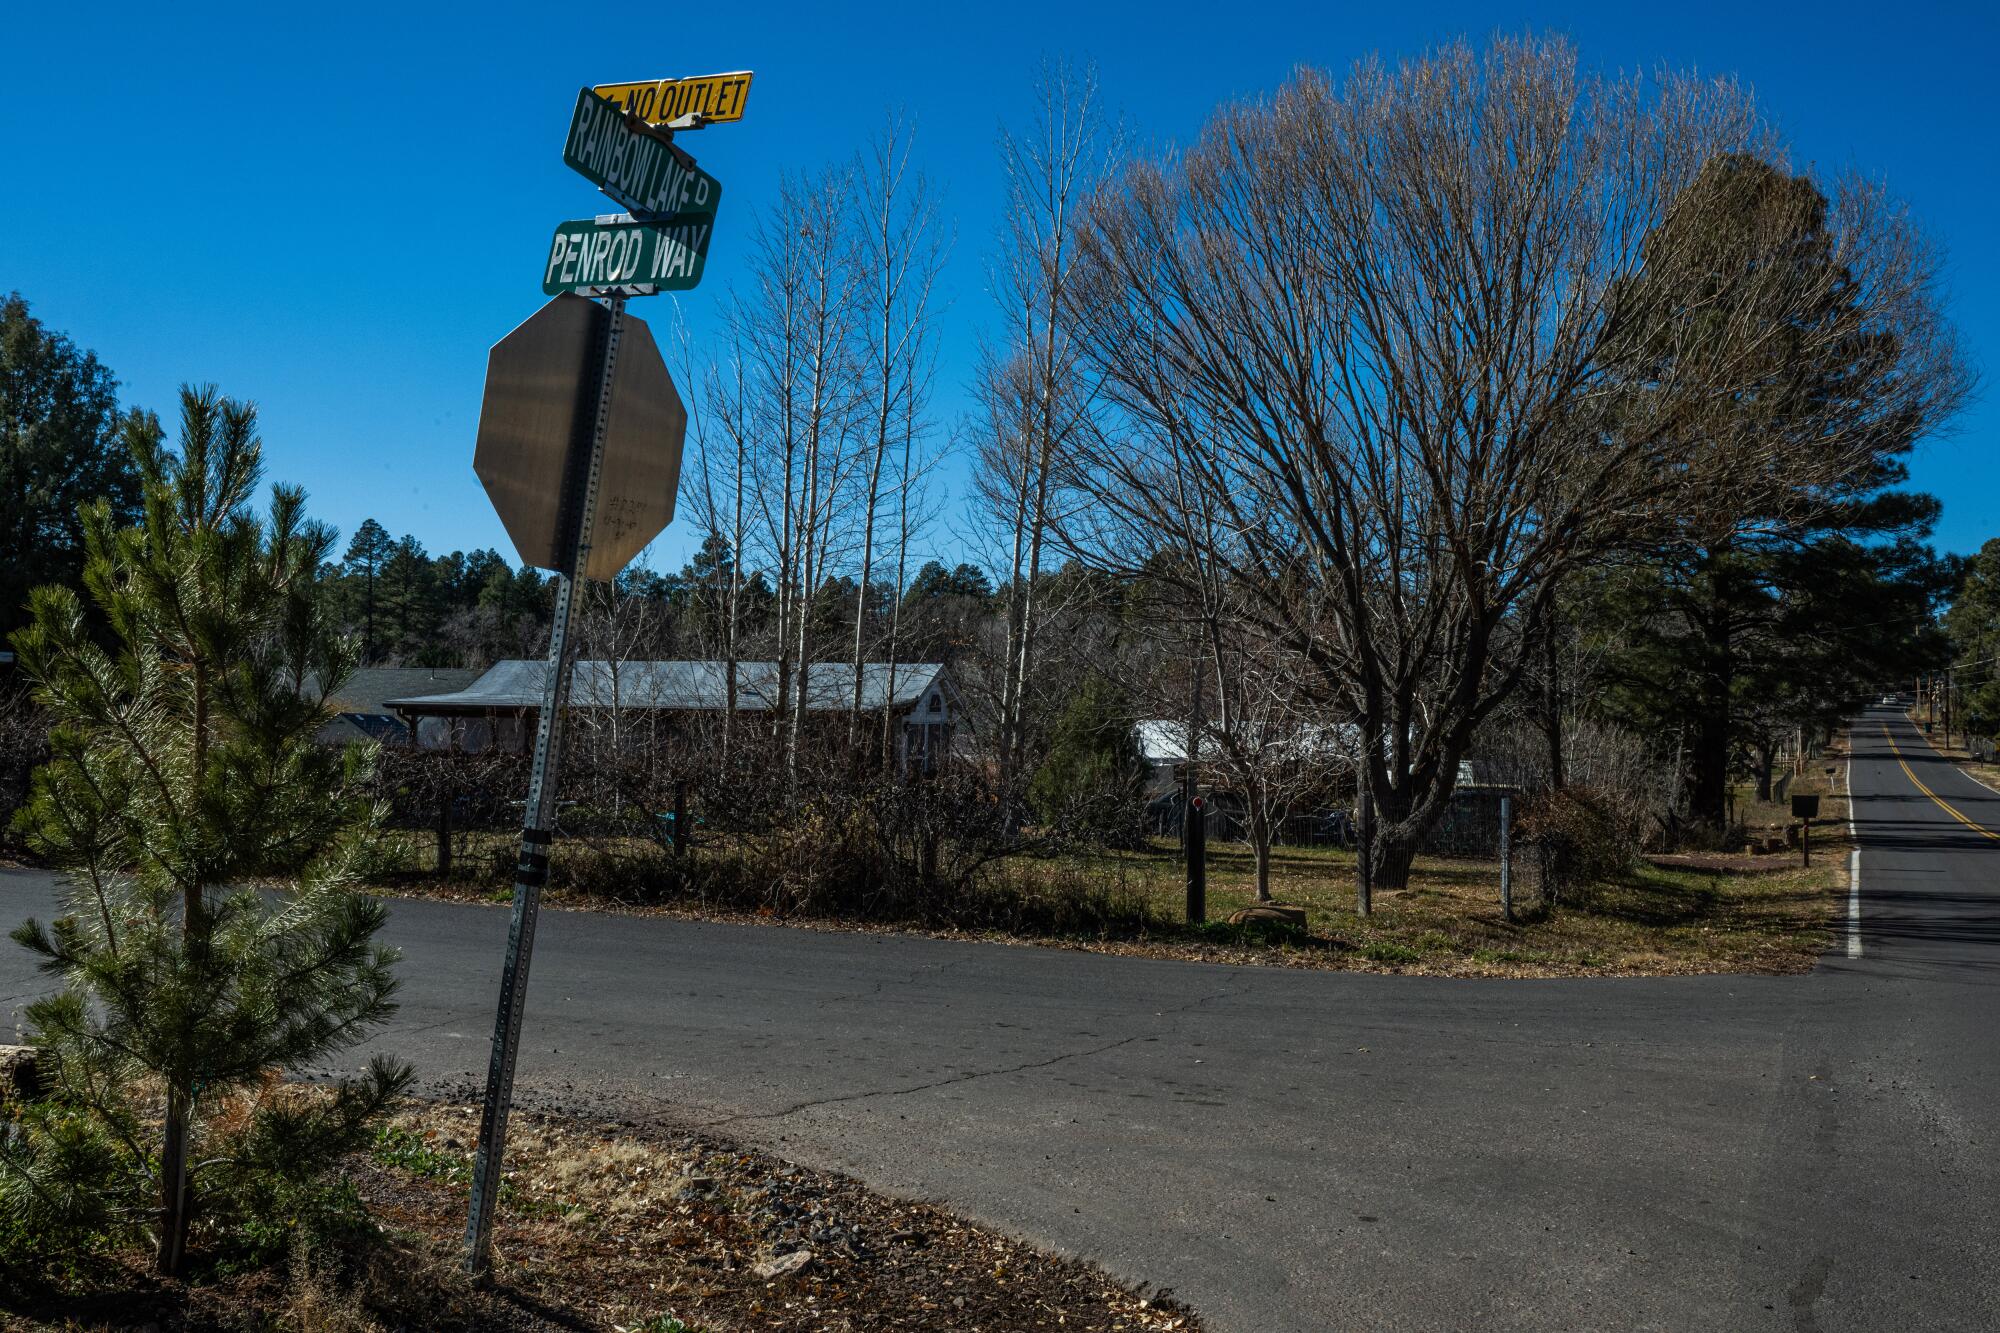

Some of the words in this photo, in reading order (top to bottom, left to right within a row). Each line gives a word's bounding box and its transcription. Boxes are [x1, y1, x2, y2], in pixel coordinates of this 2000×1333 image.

[626, 87, 657, 120] NO
[659, 80, 746, 120] OUTLET
[571, 95, 656, 201] RAINBOW
[646, 148, 696, 213] LAKE
[546, 230, 643, 284] PENROD
[651, 225, 708, 279] WAY
